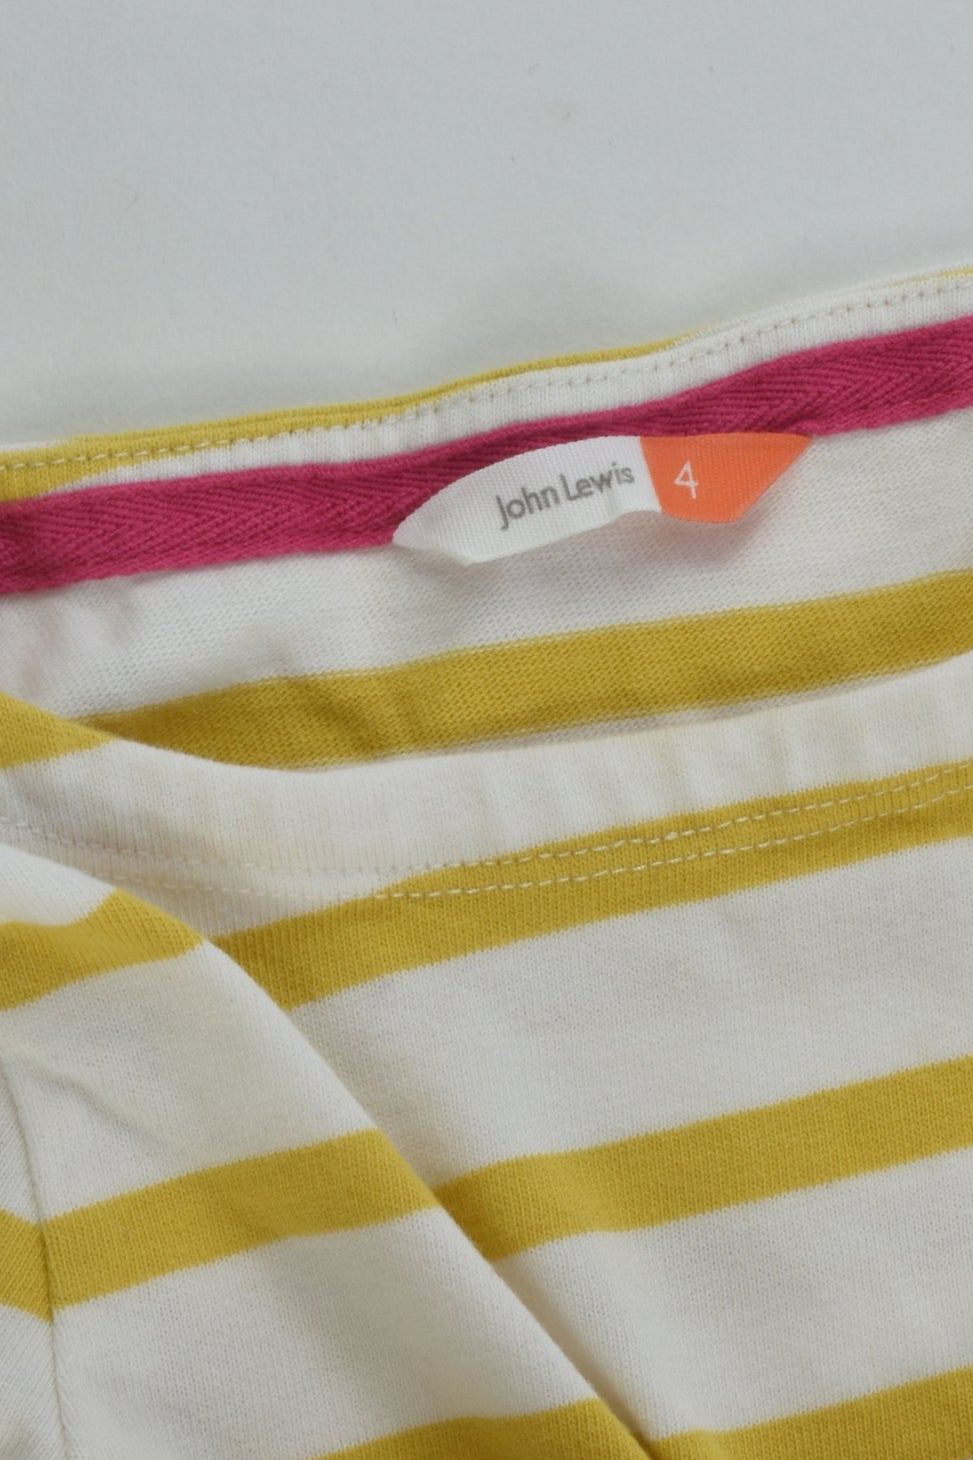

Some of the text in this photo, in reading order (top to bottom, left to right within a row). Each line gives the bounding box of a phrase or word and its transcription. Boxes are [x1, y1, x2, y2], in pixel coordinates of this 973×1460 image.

[496, 461, 636, 531] John Lewis
[674, 460, 699, 499] 4
